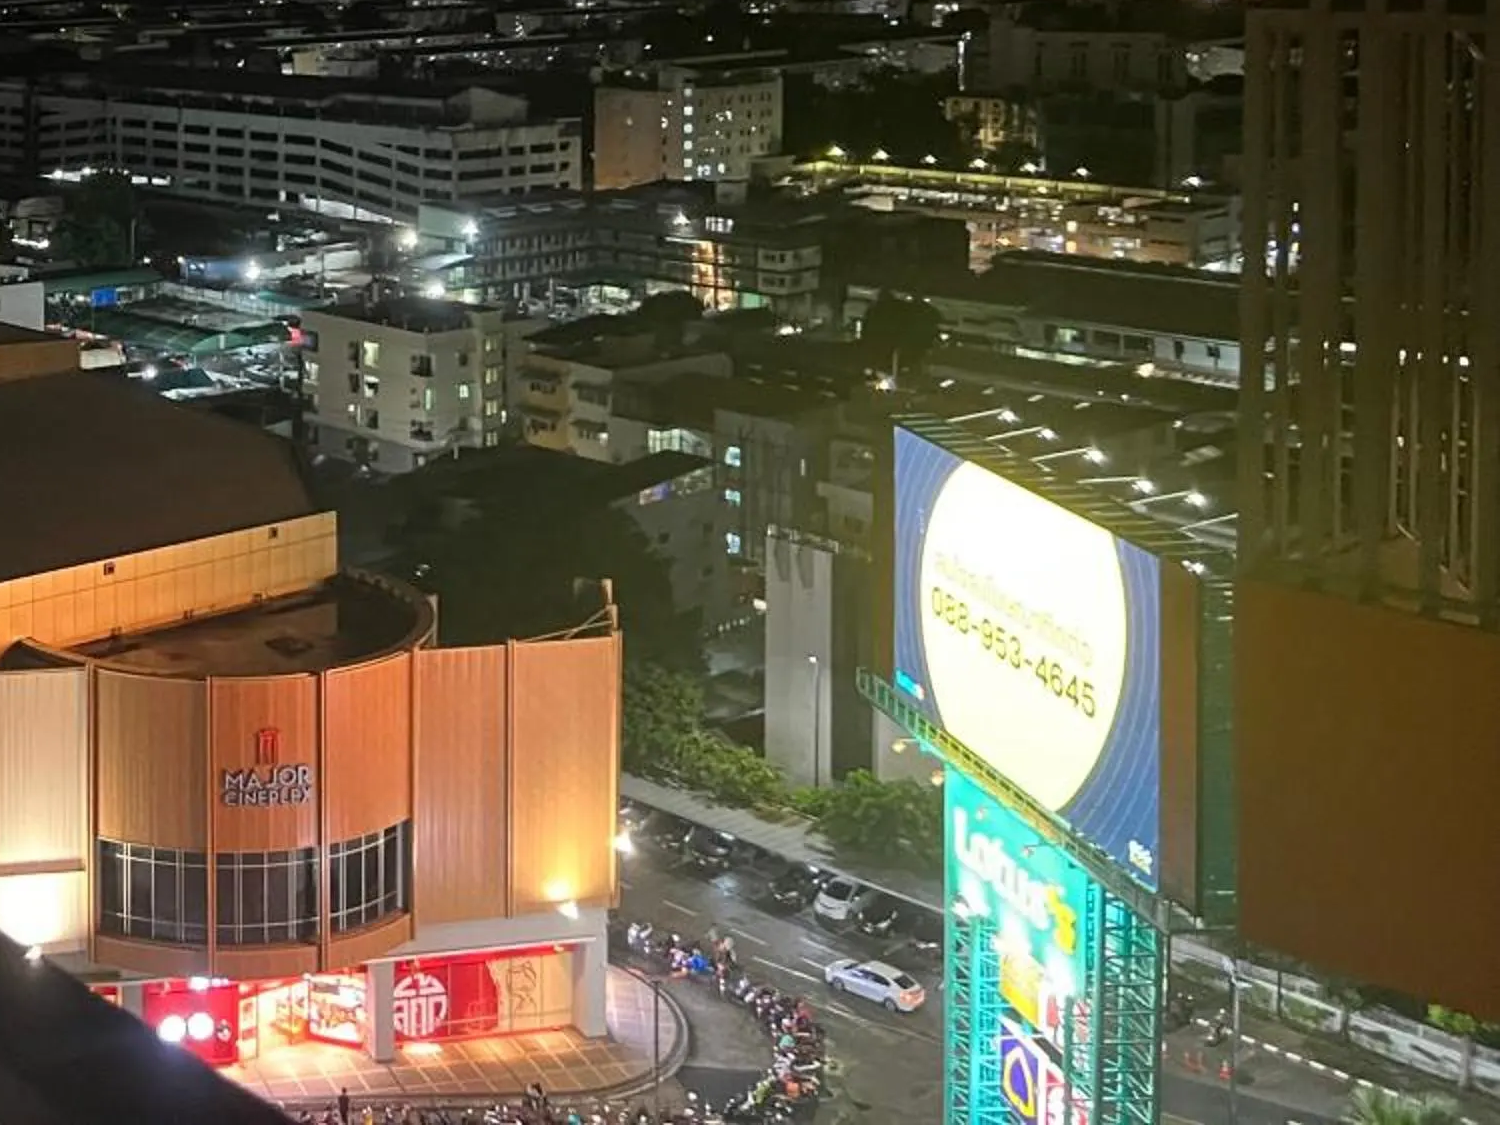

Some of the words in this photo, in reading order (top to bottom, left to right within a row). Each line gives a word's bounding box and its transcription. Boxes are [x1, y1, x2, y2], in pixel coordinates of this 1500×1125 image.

[931, 586, 1096, 718] 088-953-4645
[225, 765, 312, 790] MAJOR
[225, 785, 312, 806] CINEPLEX
